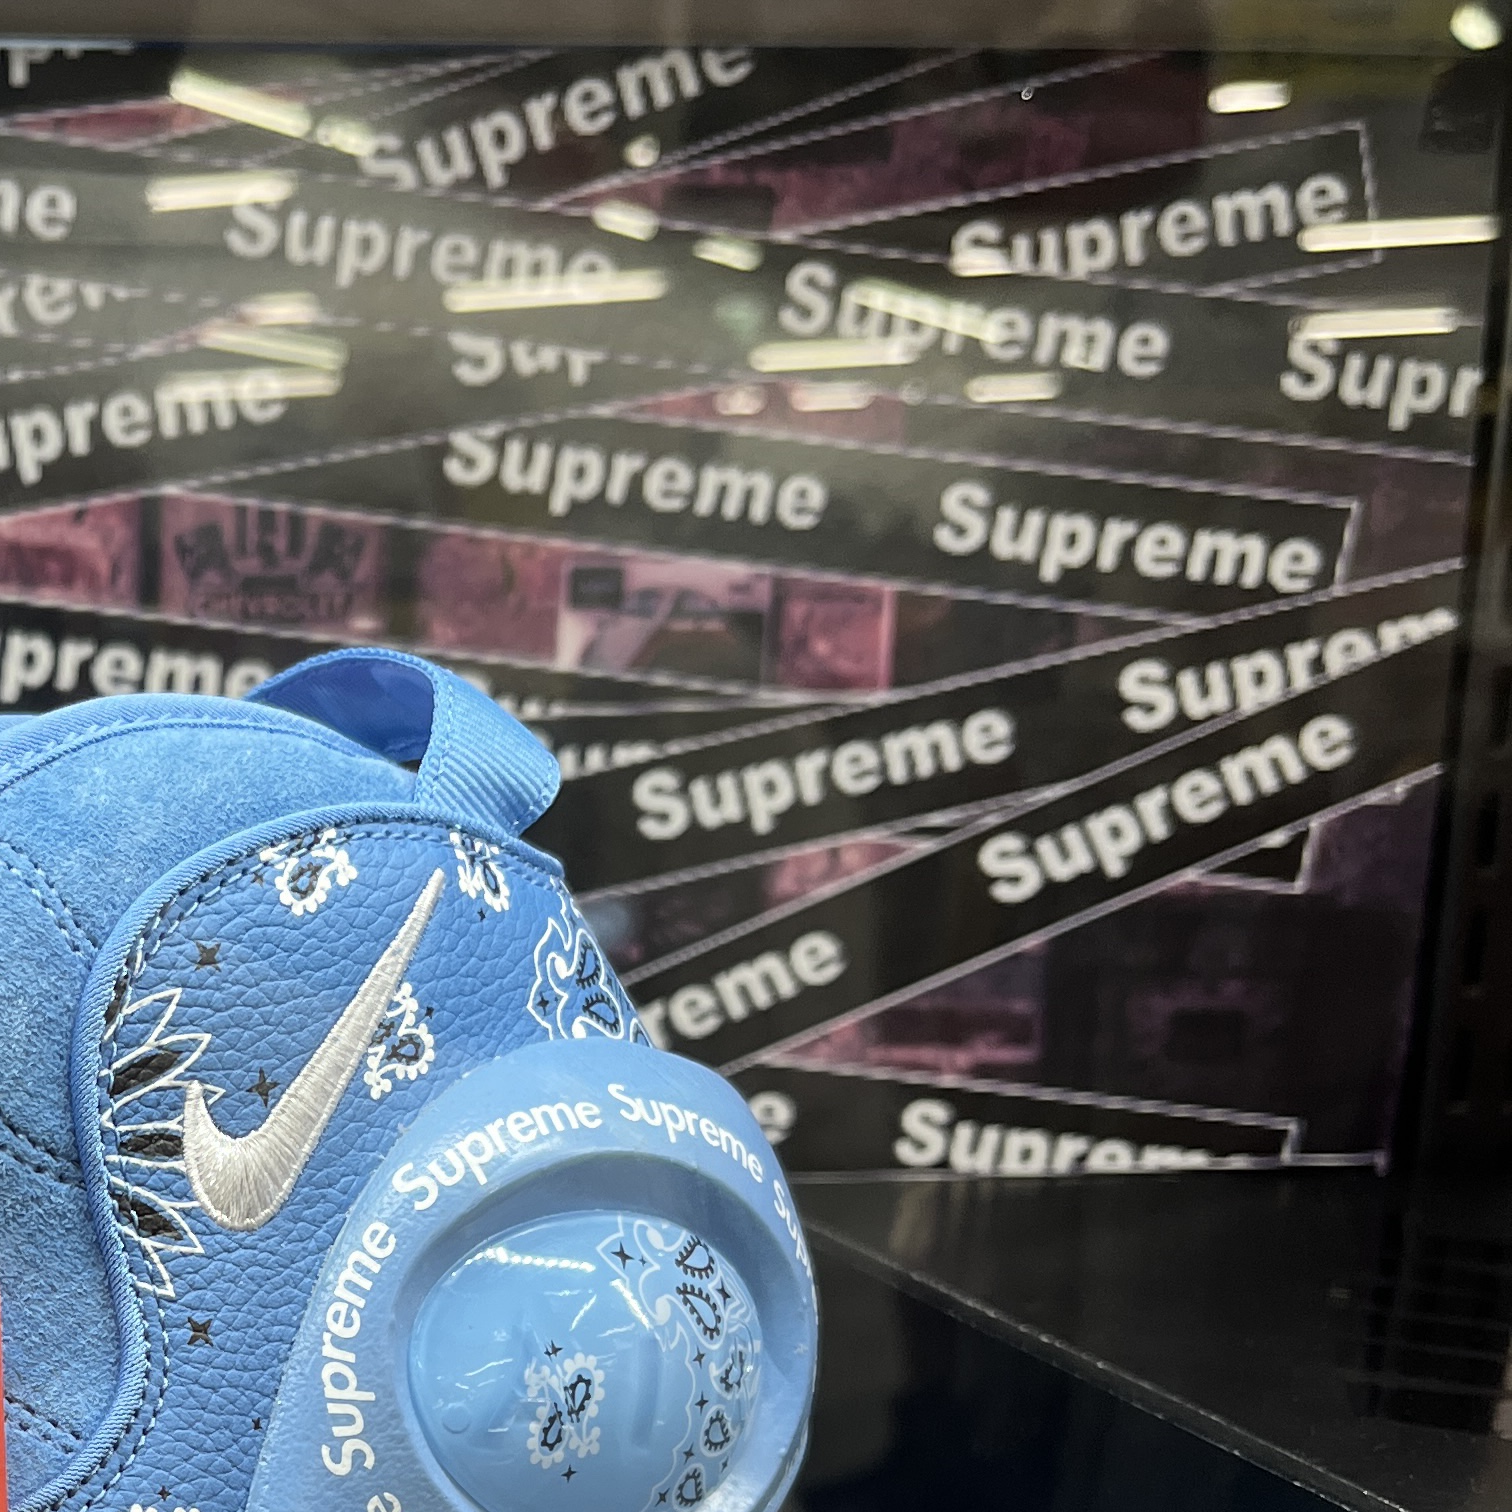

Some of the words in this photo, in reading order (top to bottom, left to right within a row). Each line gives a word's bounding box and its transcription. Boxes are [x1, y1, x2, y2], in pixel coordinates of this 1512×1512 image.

[358, 47, 756, 191] Supreme
[225, 190, 616, 289] Supreme
[779, 261, 1171, 378] Supreme
[1279, 334, 1482, 431] Supr
[443, 425, 829, 532] Supreme
[933, 481, 1323, 595] Supreme
[630, 708, 1018, 840] Supreme
[976, 712, 1356, 904] Supreme
[391, 1096, 603, 1212] Supreme
[605, 1081, 766, 1186] Supreme
[320, 1219, 398, 1478] Supreme
